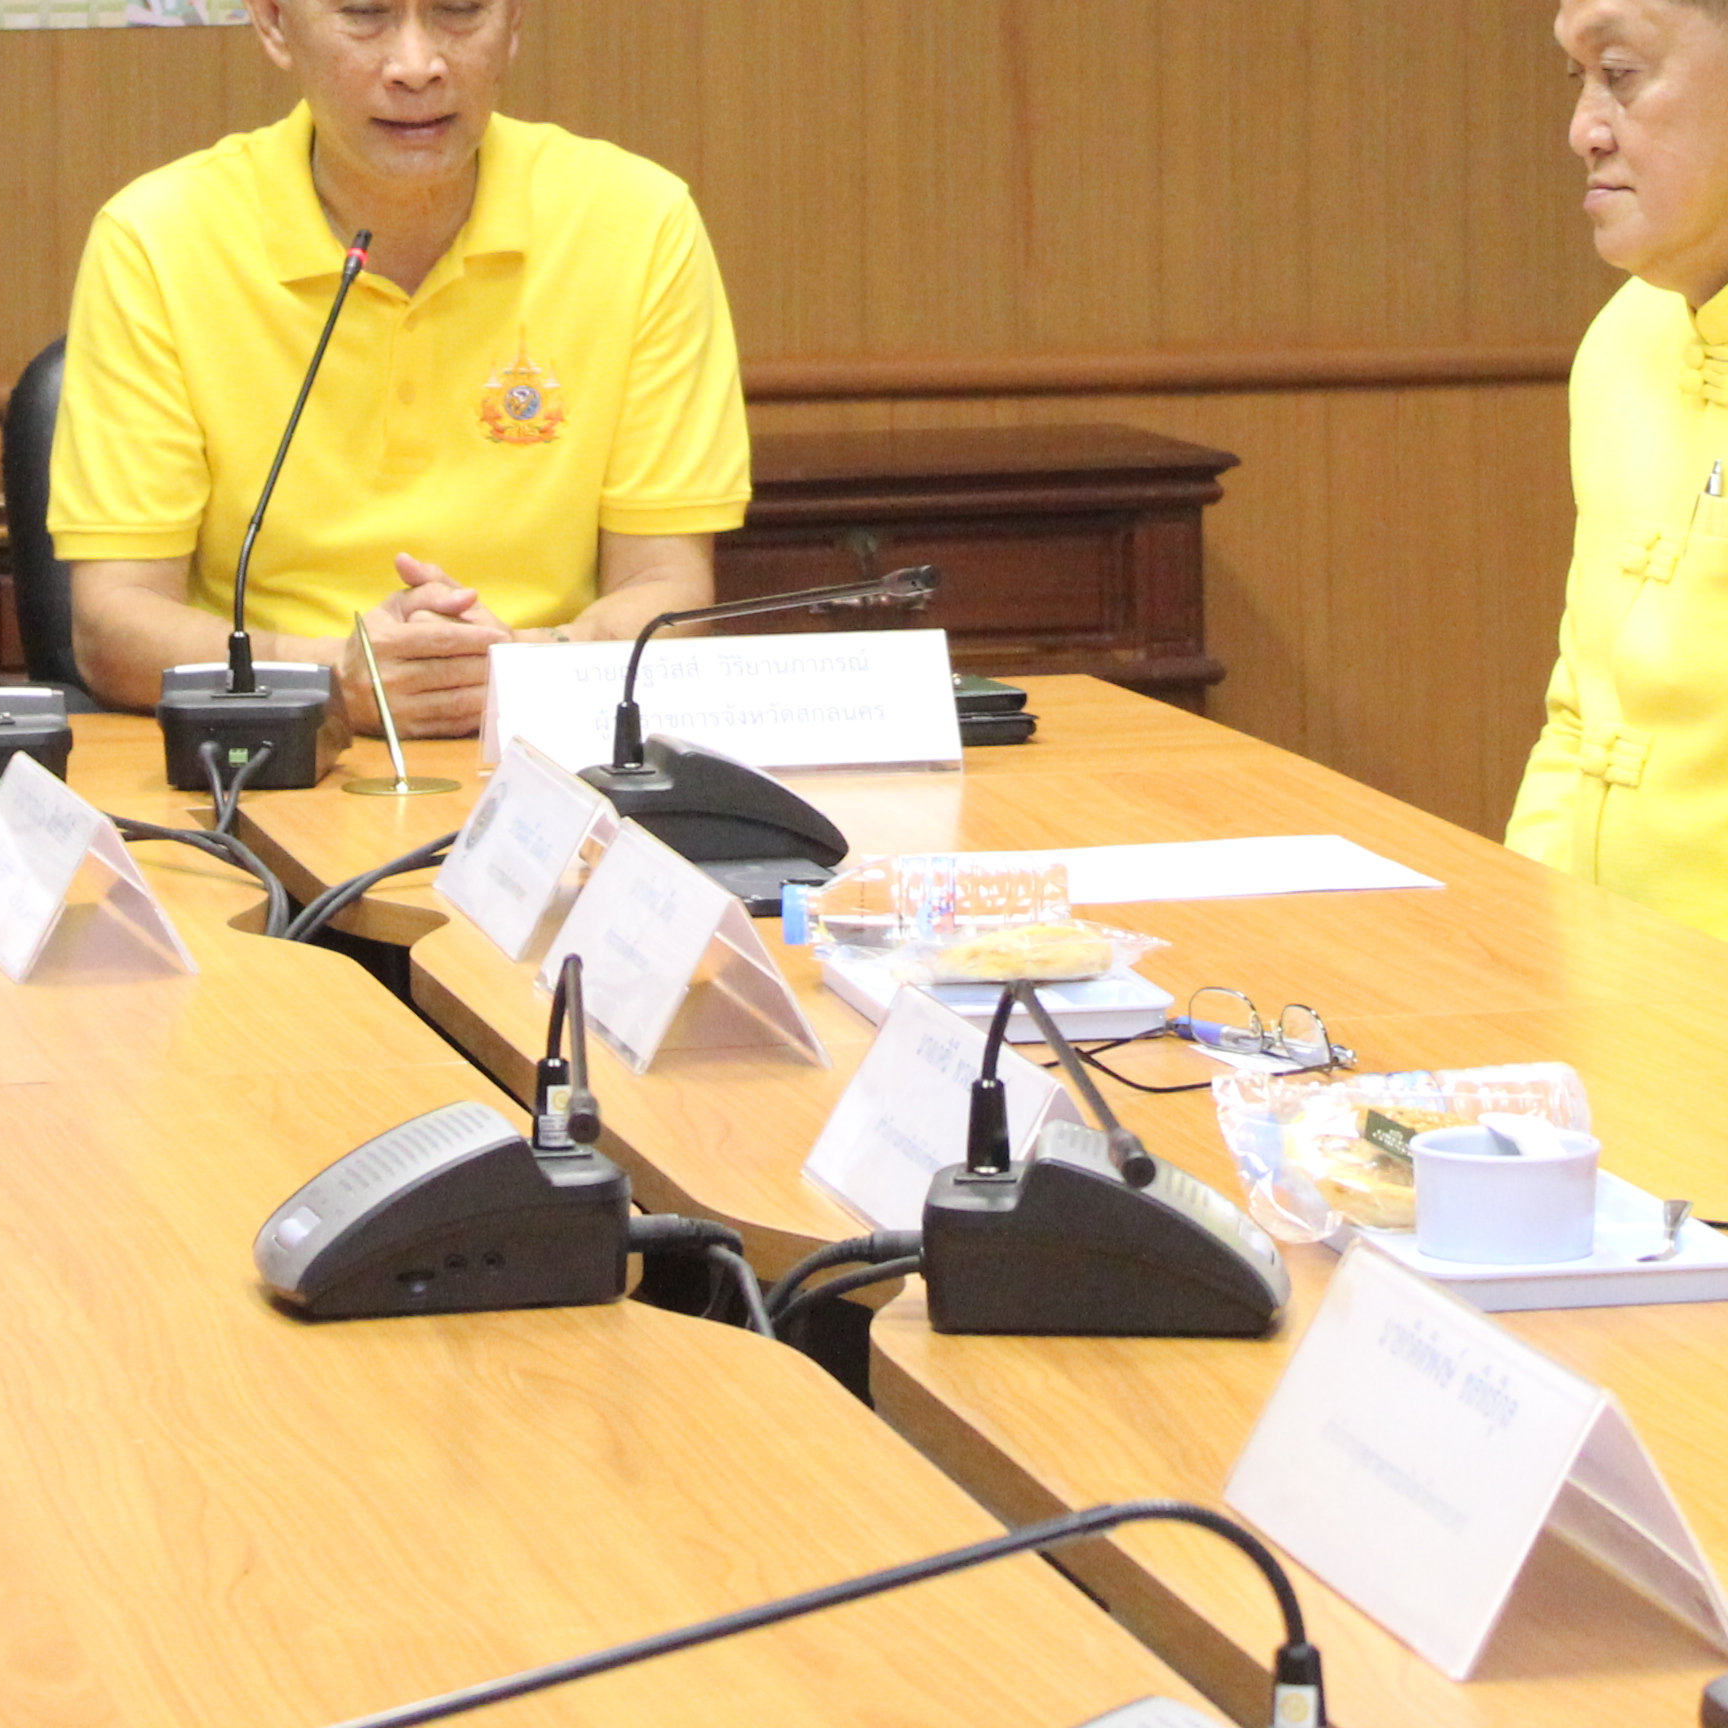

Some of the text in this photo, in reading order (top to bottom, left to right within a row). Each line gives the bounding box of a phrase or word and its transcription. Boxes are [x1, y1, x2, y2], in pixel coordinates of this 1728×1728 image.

[593, 700, 886, 740] ผู้ราชการจังหวัดสกลนคร
